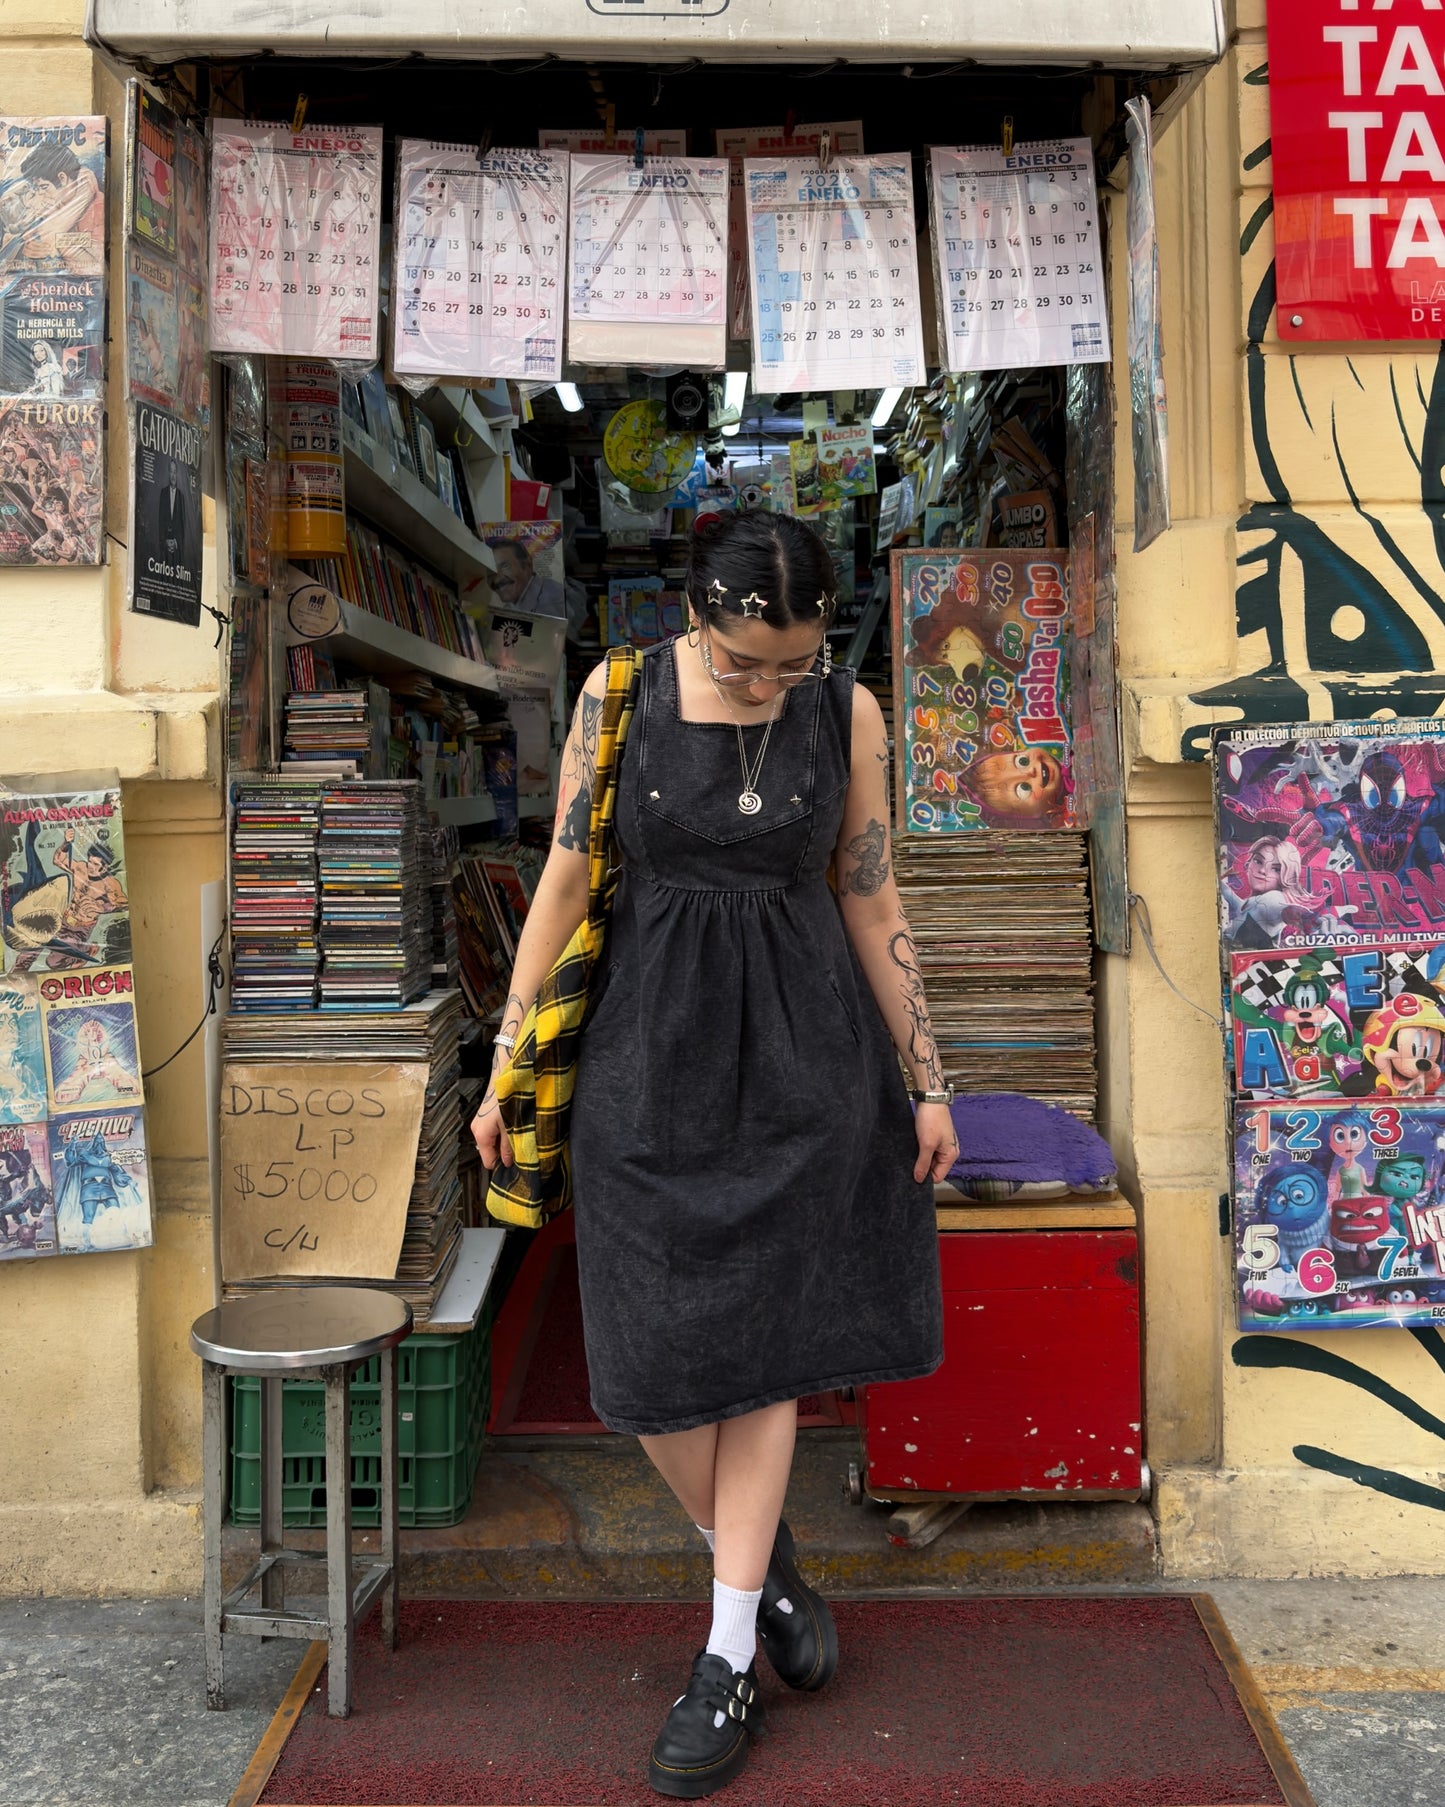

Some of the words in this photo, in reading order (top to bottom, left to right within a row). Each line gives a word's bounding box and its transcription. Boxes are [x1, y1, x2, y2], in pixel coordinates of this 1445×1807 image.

[1322, 26, 1445, 96] TA
[8, 122, 87, 148] CHANOC
[1006, 154, 1072, 168] ENERO
[803, 175, 852, 187] 2026
[798, 187, 860, 201] ENERO
[842, 212, 847, 220] 1
[865, 211, 870, 219] 2
[887, 210, 893, 218] 3
[778, 243, 784, 252] 5
[800, 243, 806, 252] 6
[822, 242, 827, 251] 7
[845, 241, 851, 250] 8
[866, 240, 873, 249] 9
[889, 239, 899, 248] 10
[758, 274, 766, 283] 11
[779, 273, 789, 282] 12
[802, 272, 812, 281] 13
[824, 272, 834, 280] 14
[846, 271, 857, 280] 15
[868, 270, 879, 279] 16
[891, 269, 900, 278] 17
[33, 282, 94, 297] Sherlock
[30, 300, 84, 313] Holmes
[760, 304, 770, 312] 18
[782, 303, 792, 312] 19
[804, 302, 816, 311] 20
[826, 301, 836, 310] 21
[849, 300, 860, 309] 22
[870, 299, 882, 308] 23
[893, 298, 904, 307] 24
[1412, 308, 1442, 322] DE
[17, 319, 25, 328] LA
[28, 319, 63, 328] HERENCIA
[66, 318, 76, 328] DE
[17, 329, 54, 339] RICHARD
[57, 328, 84, 338] MILLS
[762, 333, 774, 342] 25
[783, 332, 796, 341] 26
[806, 331, 817, 341] 27
[828, 331, 840, 339] 28
[850, 330, 863, 338] 29
[872, 329, 884, 338] 30
[895, 328, 905, 337] 31
[21, 403, 96, 425] TUROK
[139, 408, 200, 470] GATOPARDO
[822, 428, 867, 442] Nacho
[1005, 505, 1045, 527] JUMBO
[148, 556, 174, 577] Carlos
[176, 563, 192, 582] Slim
[919, 565, 941, 605] 20
[956, 563, 979, 605] 30
[991, 562, 1013, 604] 40
[1023, 564, 1065, 617] Oso
[1040, 622, 1059, 636] el
[1002, 621, 1024, 661] 50
[1034, 636, 1051, 647] y
[917, 672, 942, 697] 7
[953, 682, 975, 709] 8
[987, 676, 1008, 708] 10
[1020, 650, 1067, 743] Masha
[914, 705, 939, 731] 5
[956, 710, 979, 733] 6
[989, 723, 1014, 747] 9
[1230, 730, 1242, 741] LA
[1342, 725, 1354, 737] DE
[912, 742, 936, 767] 3
[955, 738, 977, 764] 4
[933, 769, 957, 795] 2
[4, 809, 46, 824] ALMA
[47, 804, 114, 821] GRANDE
[957, 799, 981, 816] 1
[1286, 934, 1358, 946] CRUZADO
[1363, 934, 1380, 945] EL
[1343, 951, 1382, 1009] E
[1392, 993, 1419, 1017] e
[1242, 1029, 1290, 1088] A
[1293, 1056, 1320, 1081] a
[225, 1085, 386, 1118] DISCOS
[1246, 1109, 1270, 1152] 1
[1286, 1109, 1321, 1149] 2
[1369, 1107, 1402, 1146] 3
[1253, 1155, 1270, 1165] ONE
[1292, 1150, 1311, 1161] TWO
[1373, 1149, 1398, 1158] THREE
[1242, 1224, 1280, 1269] 5
[1377, 1236, 1407, 1280] 7
[1250, 1271, 1268, 1280] FIVE
[1298, 1249, 1336, 1293] 6
[1393, 1267, 1418, 1277] SEVEN
[1335, 1282, 1349, 1292] SIX
